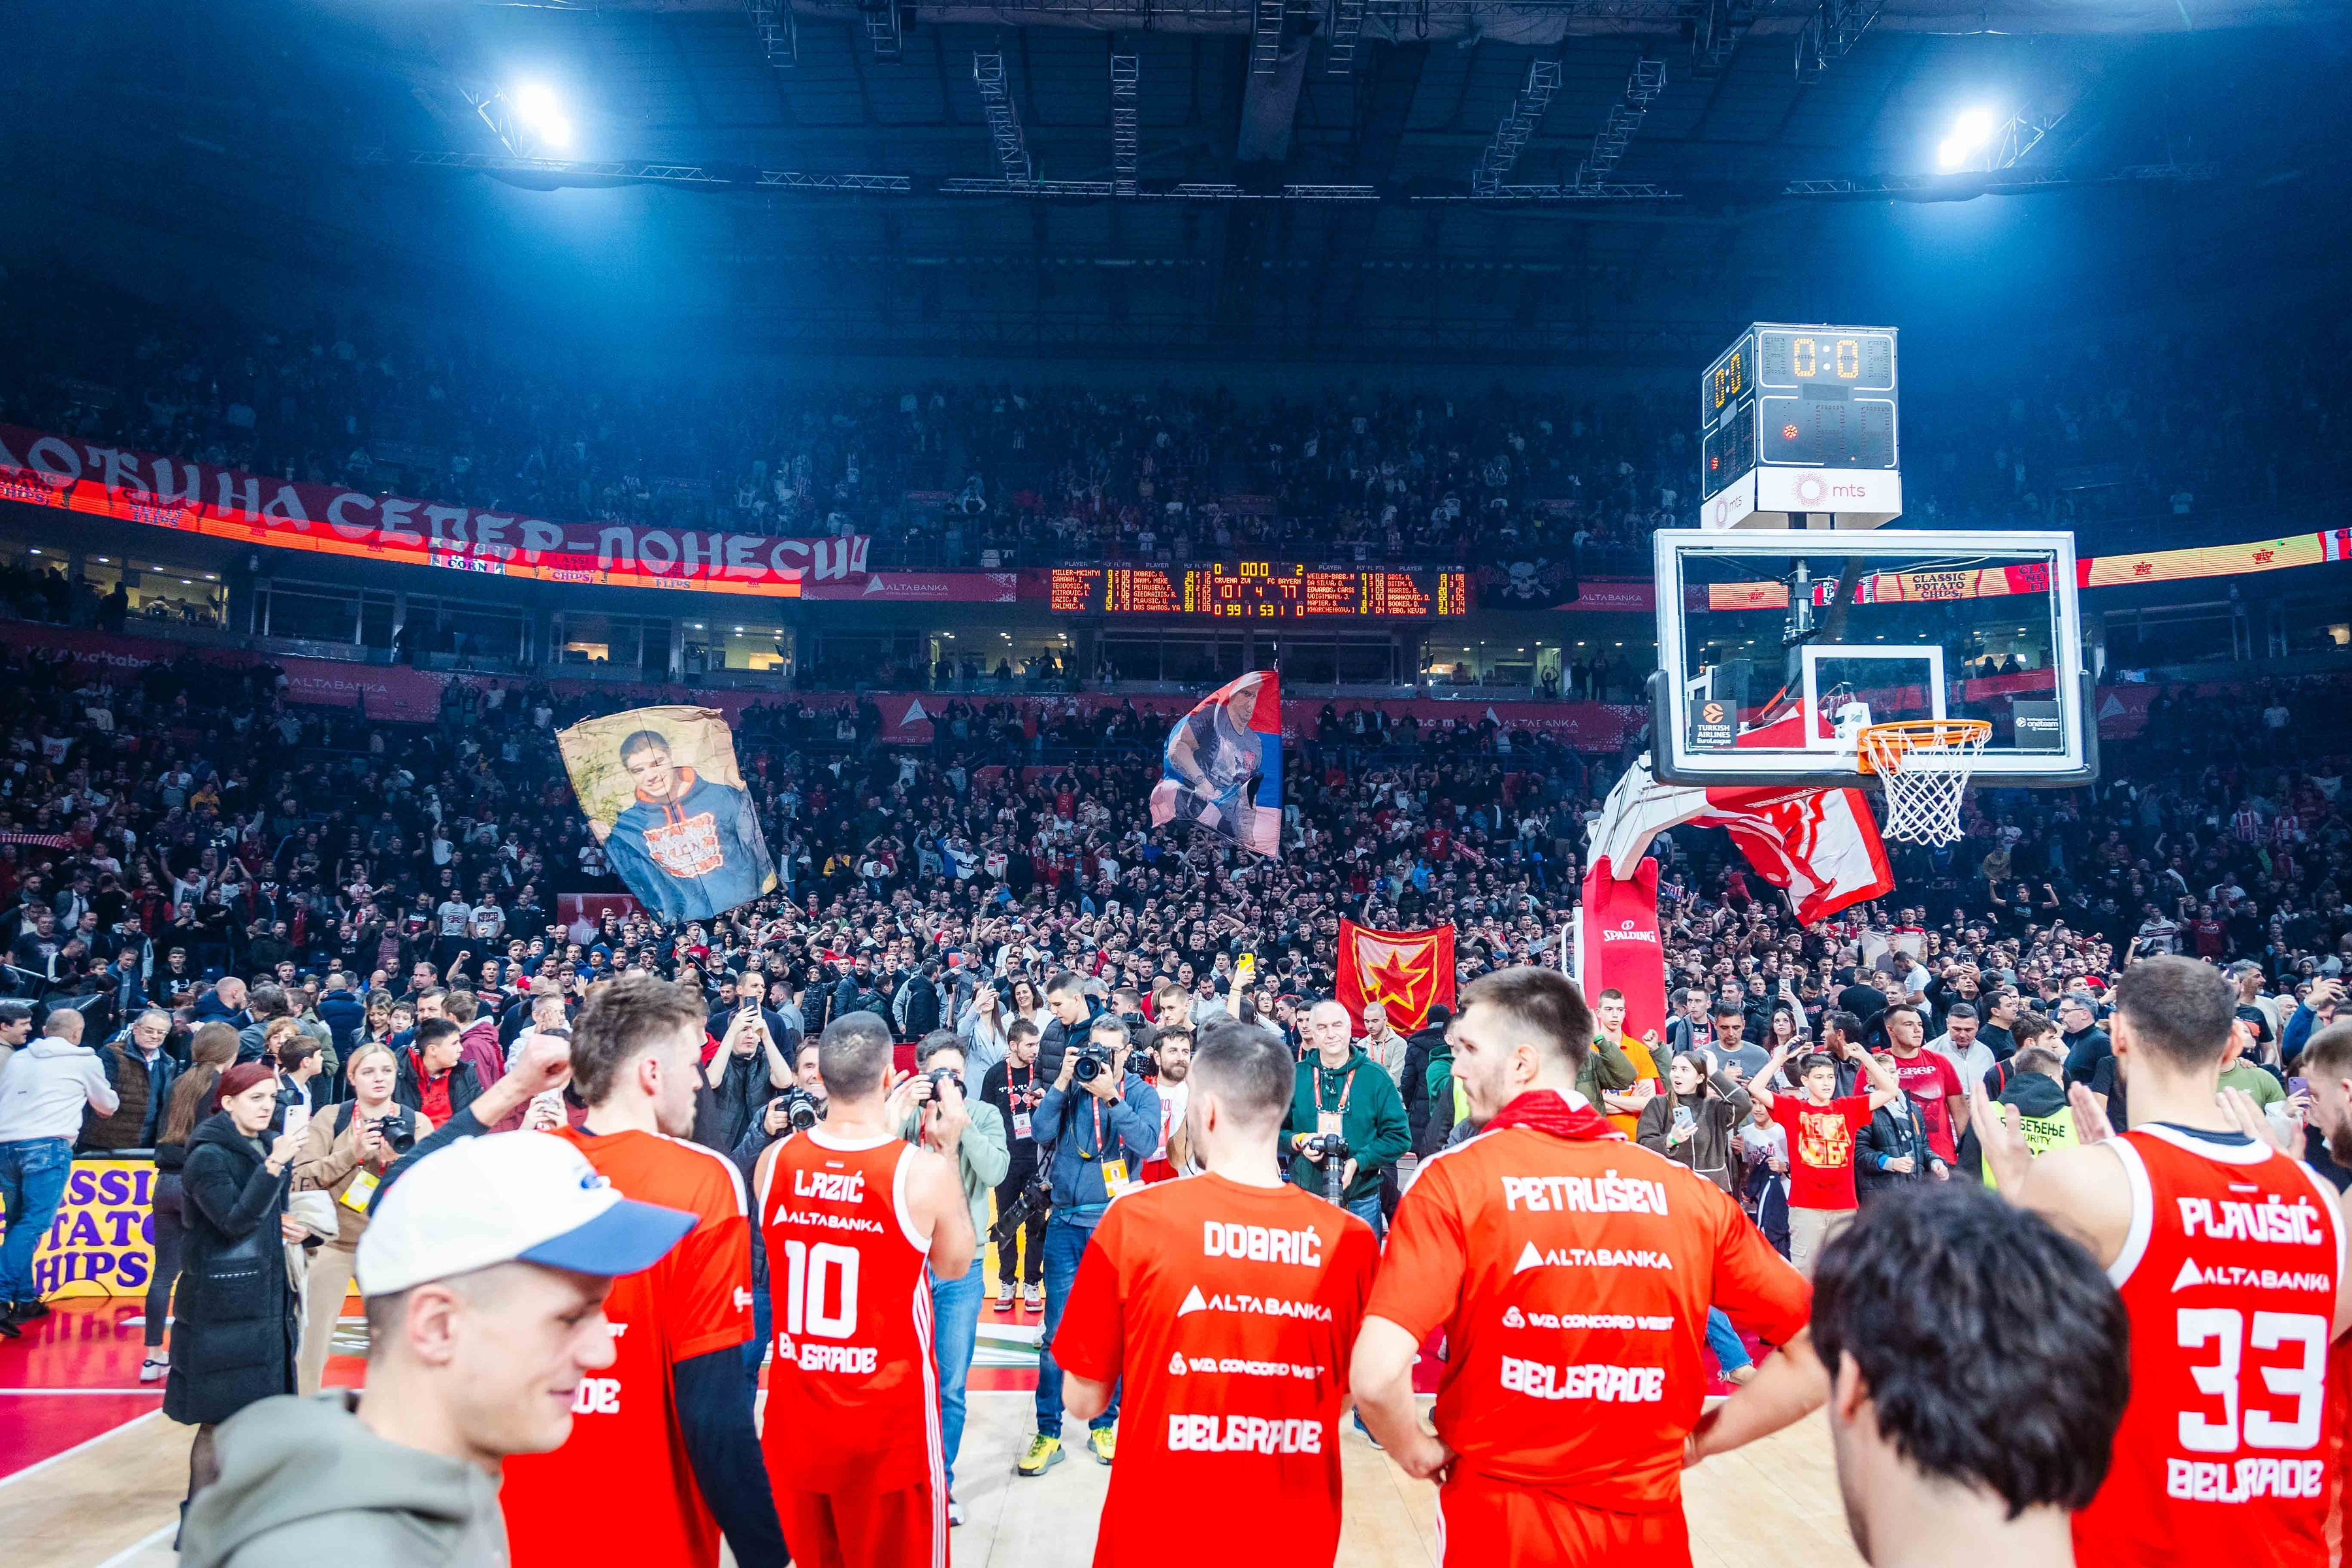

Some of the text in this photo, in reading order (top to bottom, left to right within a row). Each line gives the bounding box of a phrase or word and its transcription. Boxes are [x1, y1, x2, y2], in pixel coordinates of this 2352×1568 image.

[1794, 338, 1859, 378] 0:0
[1714, 352, 1741, 408] 0:0
[1833, 484, 1866, 497] mts
[216, 472, 312, 532] НА
[1729, 495, 1743, 513] mts
[448, 559, 488, 572] CORN
[1215, 563, 1221, 574] 0
[1296, 564, 1303, 576] 2
[1912, 572, 1966, 584] CLASSIC
[1914, 581, 1965, 591] POTATO
[1220, 585, 1241, 598] 101
[1255, 586, 1263, 597] 4
[1280, 585, 1296, 598] 77
[1215, 604, 1221, 615] 0
[1227, 604, 1241, 615] 99
[1260, 604, 1274, 616] 53
[1296, 605, 1303, 616] 0
[291, 677, 387, 693] ALTABANKA
[1603, 930, 1657, 943] SPALDING
[794, 1169, 864, 1203] LAZIĆ
[1501, 1169, 1669, 1216] PETRUŠEV
[788, 1215, 885, 1234] ALTABANKA
[2176, 1194, 2323, 1246] PLAVŠIĆ
[1204, 1220, 1322, 1268] DOBRIĆ
[1544, 1249, 1674, 1270] ALTABANKA
[35, 1251, 148, 1296] HIPS
[2203, 1266, 2330, 1293] ALTABANKA
[785, 1240, 860, 1339] 10
[1208, 1294, 1333, 1322] ALTABANKA
[1561, 1314, 1636, 1330] CONCORD
[1636, 1315, 1675, 1331] WEST
[1290, 1364, 1326, 1380] WET
[1500, 1354, 1665, 1403] BELGRADE
[2176, 1307, 2328, 1454] 33
[2166, 1458, 2325, 1503] BELRADE
